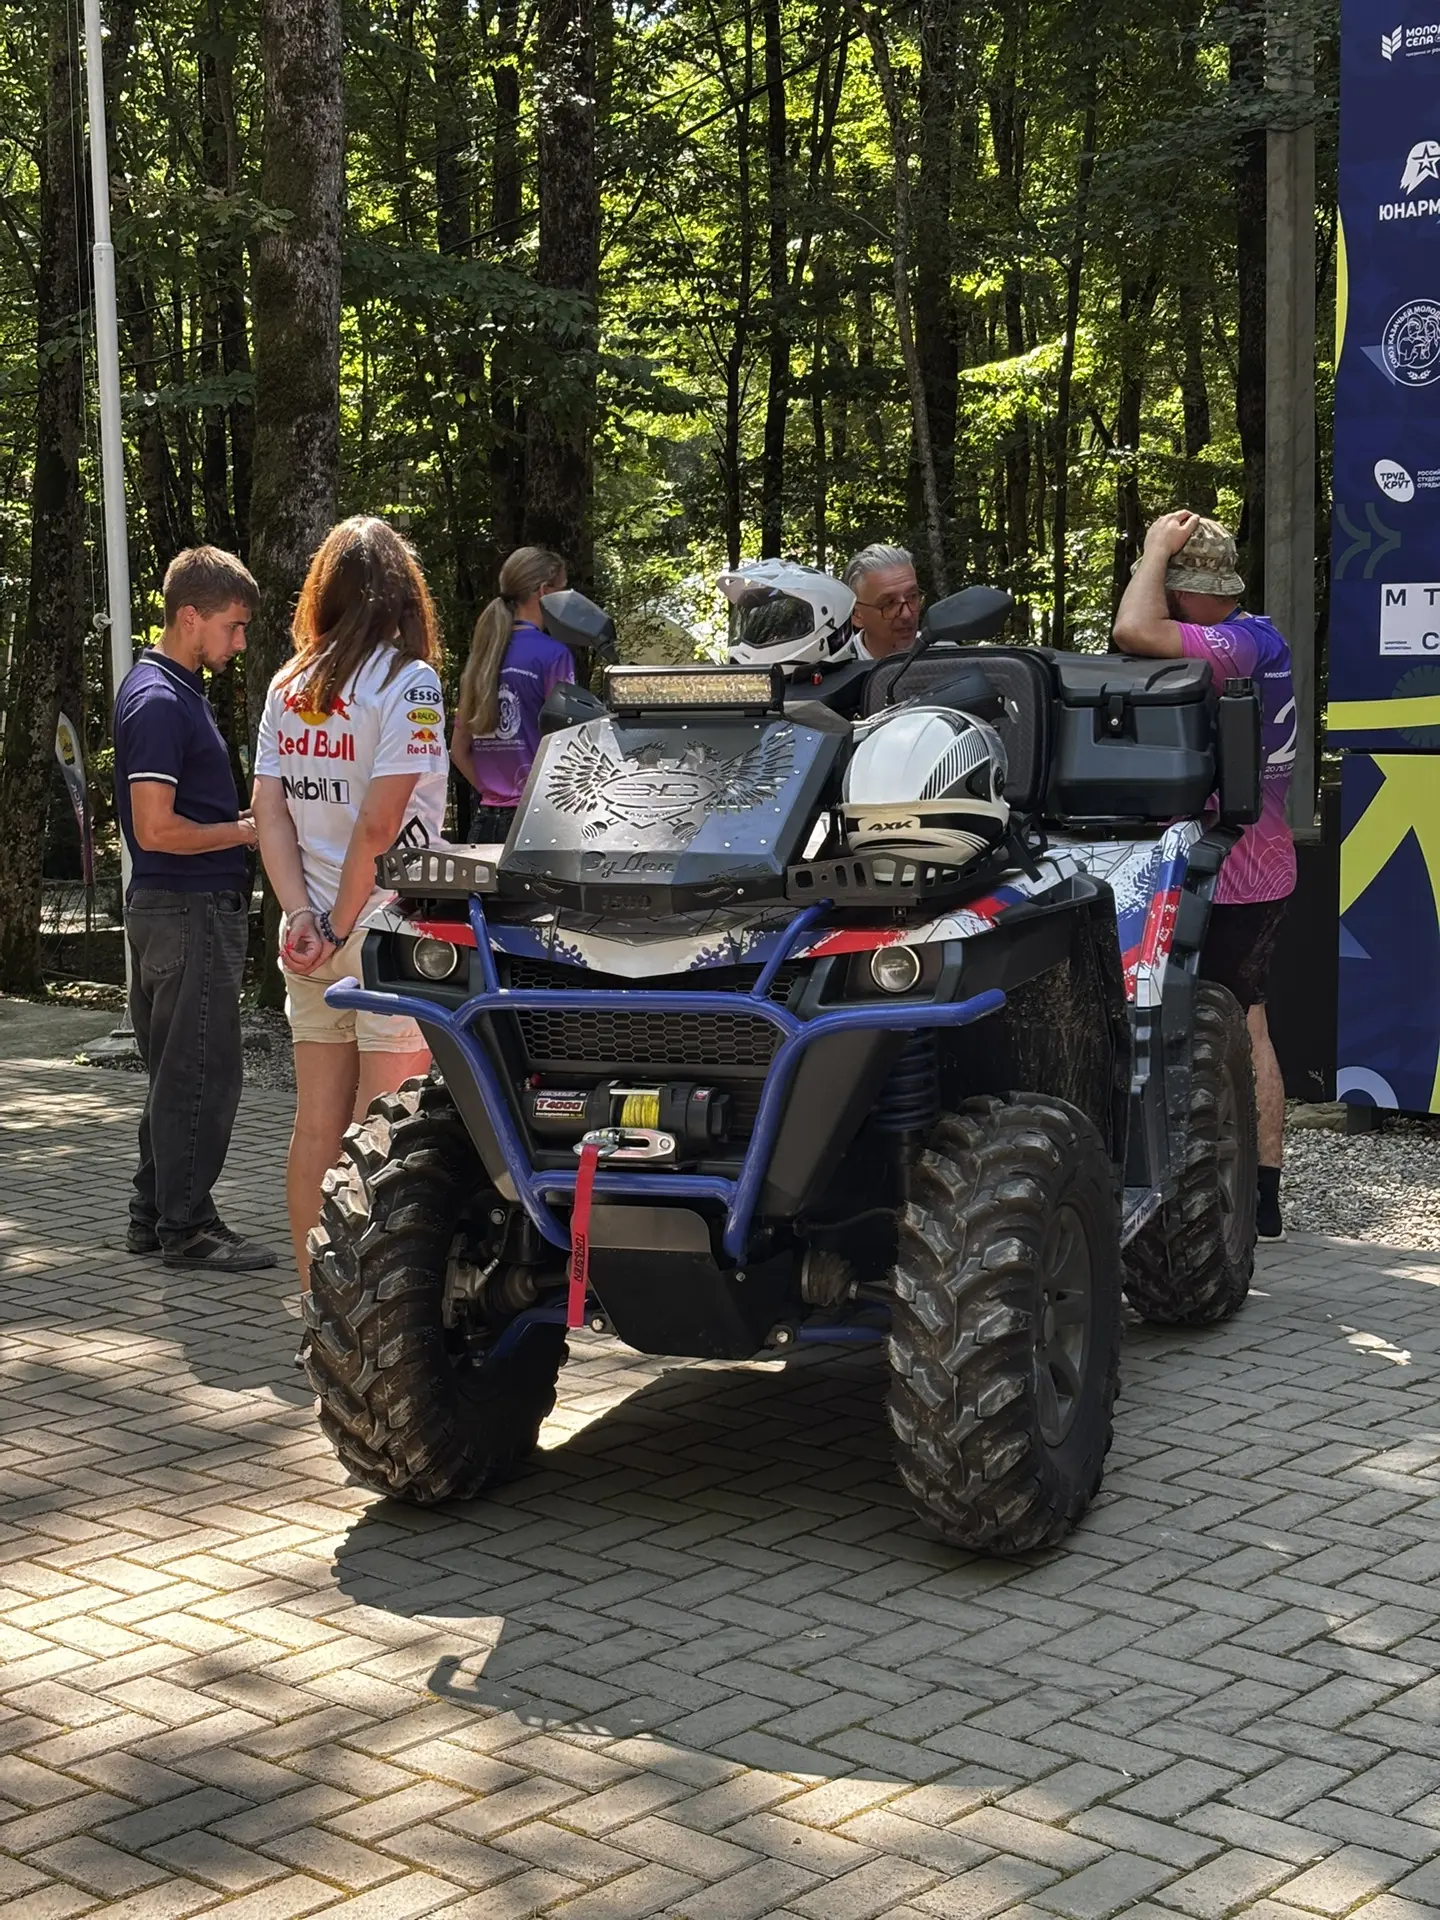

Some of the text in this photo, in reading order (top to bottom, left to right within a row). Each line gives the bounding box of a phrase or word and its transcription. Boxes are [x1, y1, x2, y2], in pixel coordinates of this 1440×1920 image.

[1405, 24, 1440, 38] МОЛО
[1405, 35, 1434, 48] СЕЛА
[1379, 198, 1440, 221] ЮНАРМ
[1380, 472, 1405, 481] ТРУД
[1383, 480, 1411, 490] КРУТ
[313, 730, 356, 762] Bull
[407, 743, 442, 757] Red Bull
[331, 781, 342, 802] 1
[537, 1099, 582, 1110] T4000
